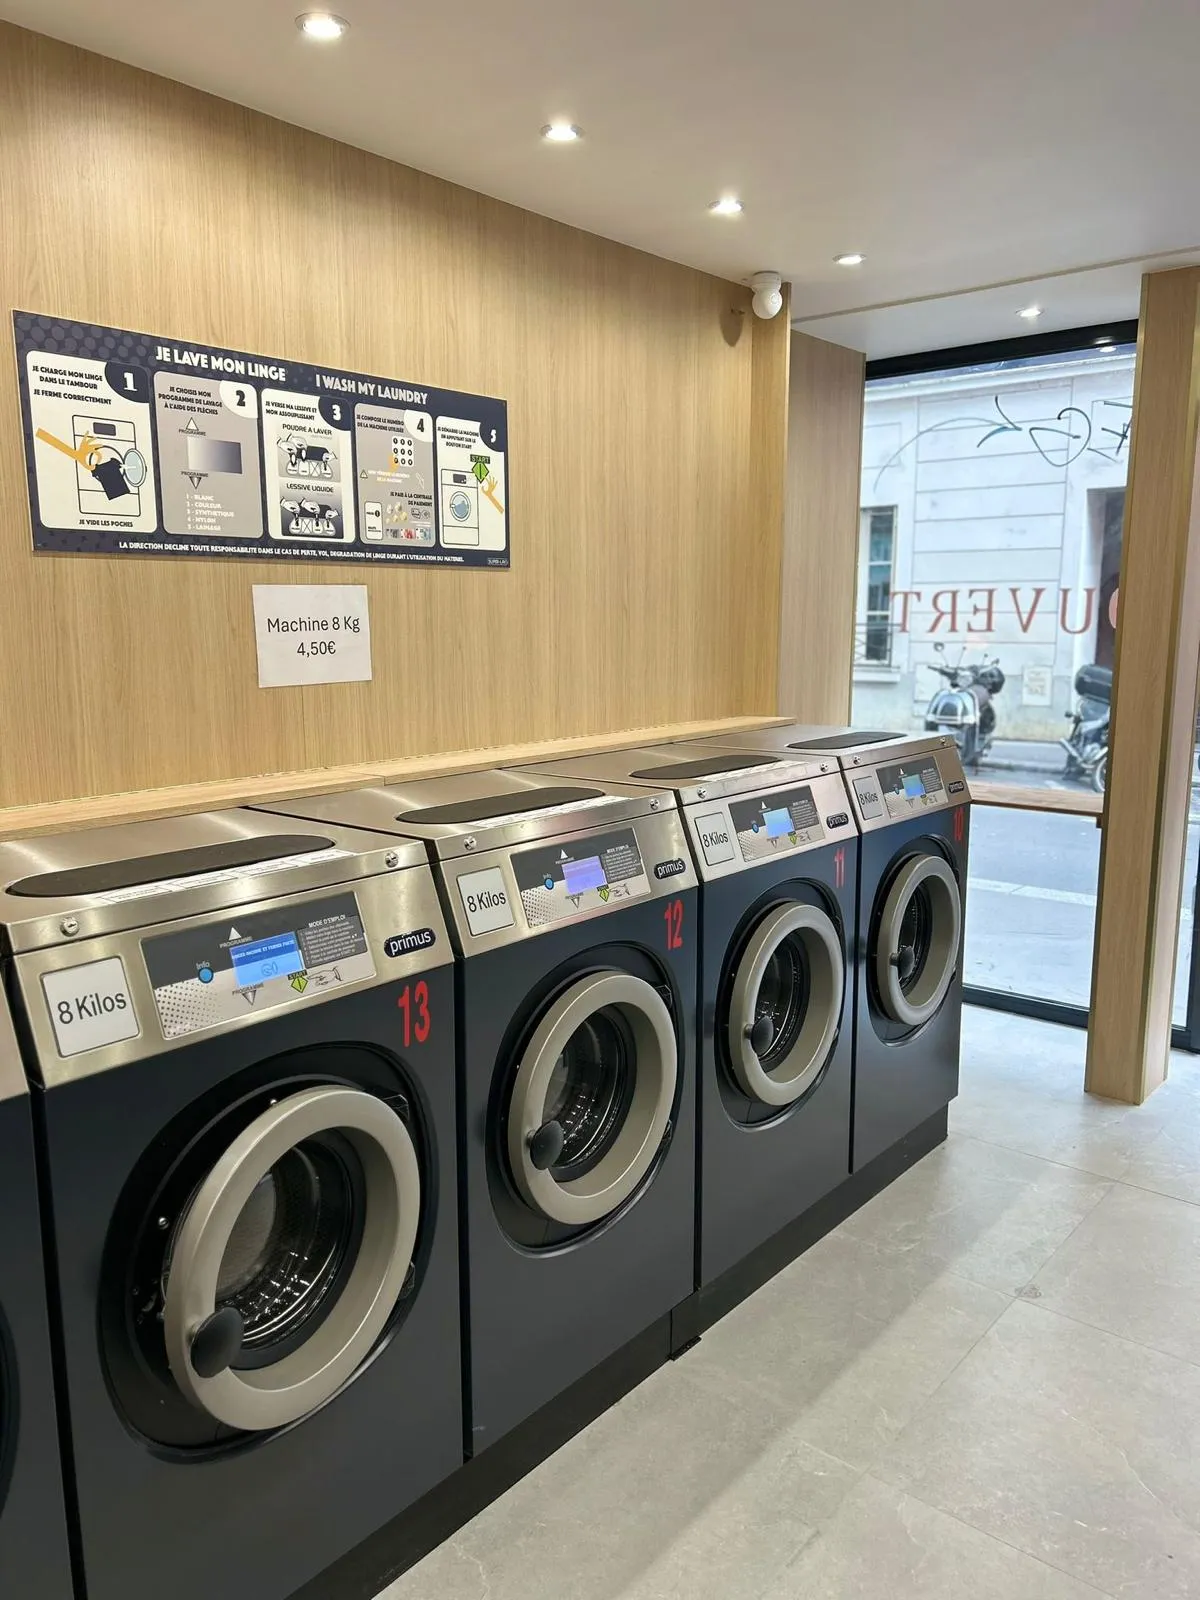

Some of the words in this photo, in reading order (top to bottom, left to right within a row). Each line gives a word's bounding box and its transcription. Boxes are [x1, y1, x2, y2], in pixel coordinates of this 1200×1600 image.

[156, 346, 171, 362] JE
[174, 349, 209, 368] LAVE
[211, 356, 245, 374] MON
[248, 362, 286, 381] LINGE
[40, 367, 67, 376] CHARGE
[68, 371, 84, 379] MON
[40, 376, 57, 384] DANS
[67, 380, 98, 390] TAMBOUR
[124, 372, 138, 392] 1
[42, 390, 62, 398] FERME
[63, 393, 111, 405] CORRECTEMENT
[316, 374, 320, 387] I
[323, 375, 355, 393] WASH
[359, 381, 375, 398] MY
[378, 385, 428, 406] LAUNDRY
[158, 393, 194, 403] PROGRAMME
[203, 399, 223, 408] LAVAGE
[236, 390, 246, 407] 2
[332, 405, 341, 421] 3
[362, 415, 381, 423] COMPOSE
[282, 424, 307, 432] POUDRE
[314, 428, 332, 436] LAVER
[417, 419, 425, 432] 4
[491, 429, 497, 443] 5
[287, 483, 311, 491] LESSIVE
[130, 542, 163, 551] DIRECTION
[164, 544, 189, 552] DECLINE
[190, 545, 210, 553] TOUTE
[211, 546, 257, 554] RESPONSABILITE
[301, 549, 317, 557] PERTE,
[330, 551, 365, 559] DEGRADATION
[268, 617, 329, 632] Machine
[332, 617, 340, 630] 8
[344, 616, 360, 633] Kg
[297, 641, 336, 658] 4,50€
[859, 794, 865, 805] 8
[865, 790, 879, 804] Kilos
[829, 814, 847, 828] primus
[704, 836, 711, 848] 8
[711, 831, 729, 847] Kilos
[657, 861, 684, 876] primus
[834, 848, 845, 888] 11
[468, 896, 477, 913] 8
[479, 891, 506, 910] Kilos
[323, 914, 346, 925] D'EMPLOI
[665, 900, 683, 950] 12
[389, 929, 432, 955] primus
[196, 961, 210, 970] Info
[289, 971, 306, 980] START
[57, 1000, 74, 1025] 8
[76, 991, 127, 1018] Kilos
[398, 980, 431, 1047] 13
